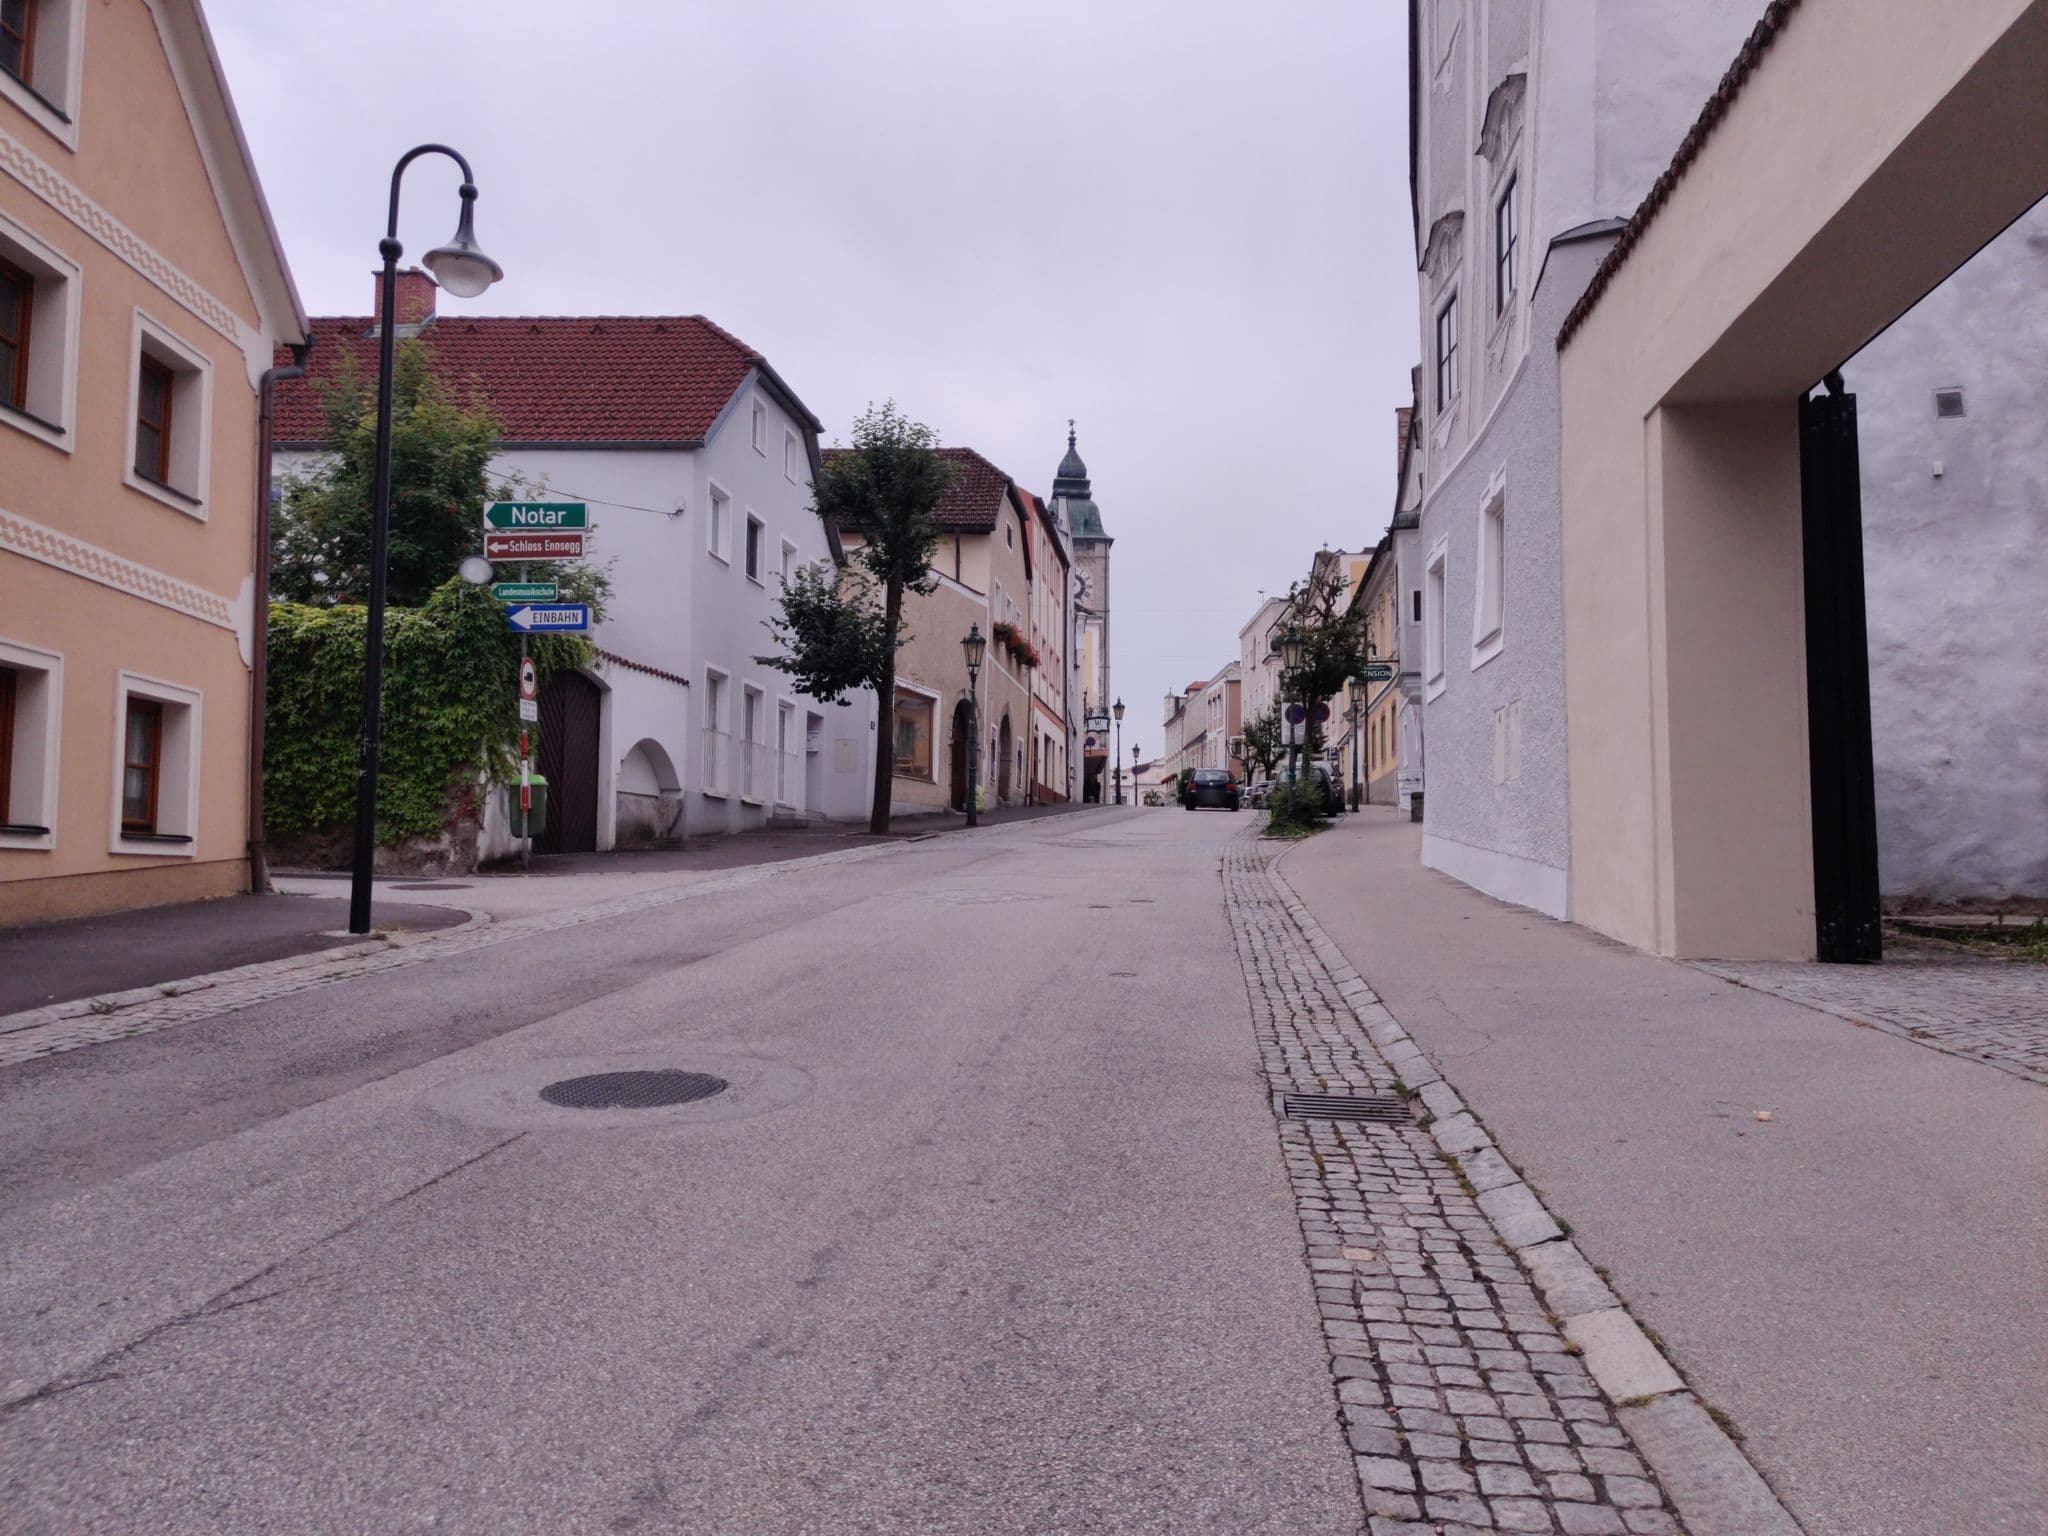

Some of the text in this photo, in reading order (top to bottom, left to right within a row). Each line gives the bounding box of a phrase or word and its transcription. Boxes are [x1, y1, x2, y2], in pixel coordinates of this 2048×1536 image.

[511, 506, 567, 525] Notar
[509, 539, 581, 554] Schloss Ennsegg
[533, 612, 579, 624] EINBAHN
